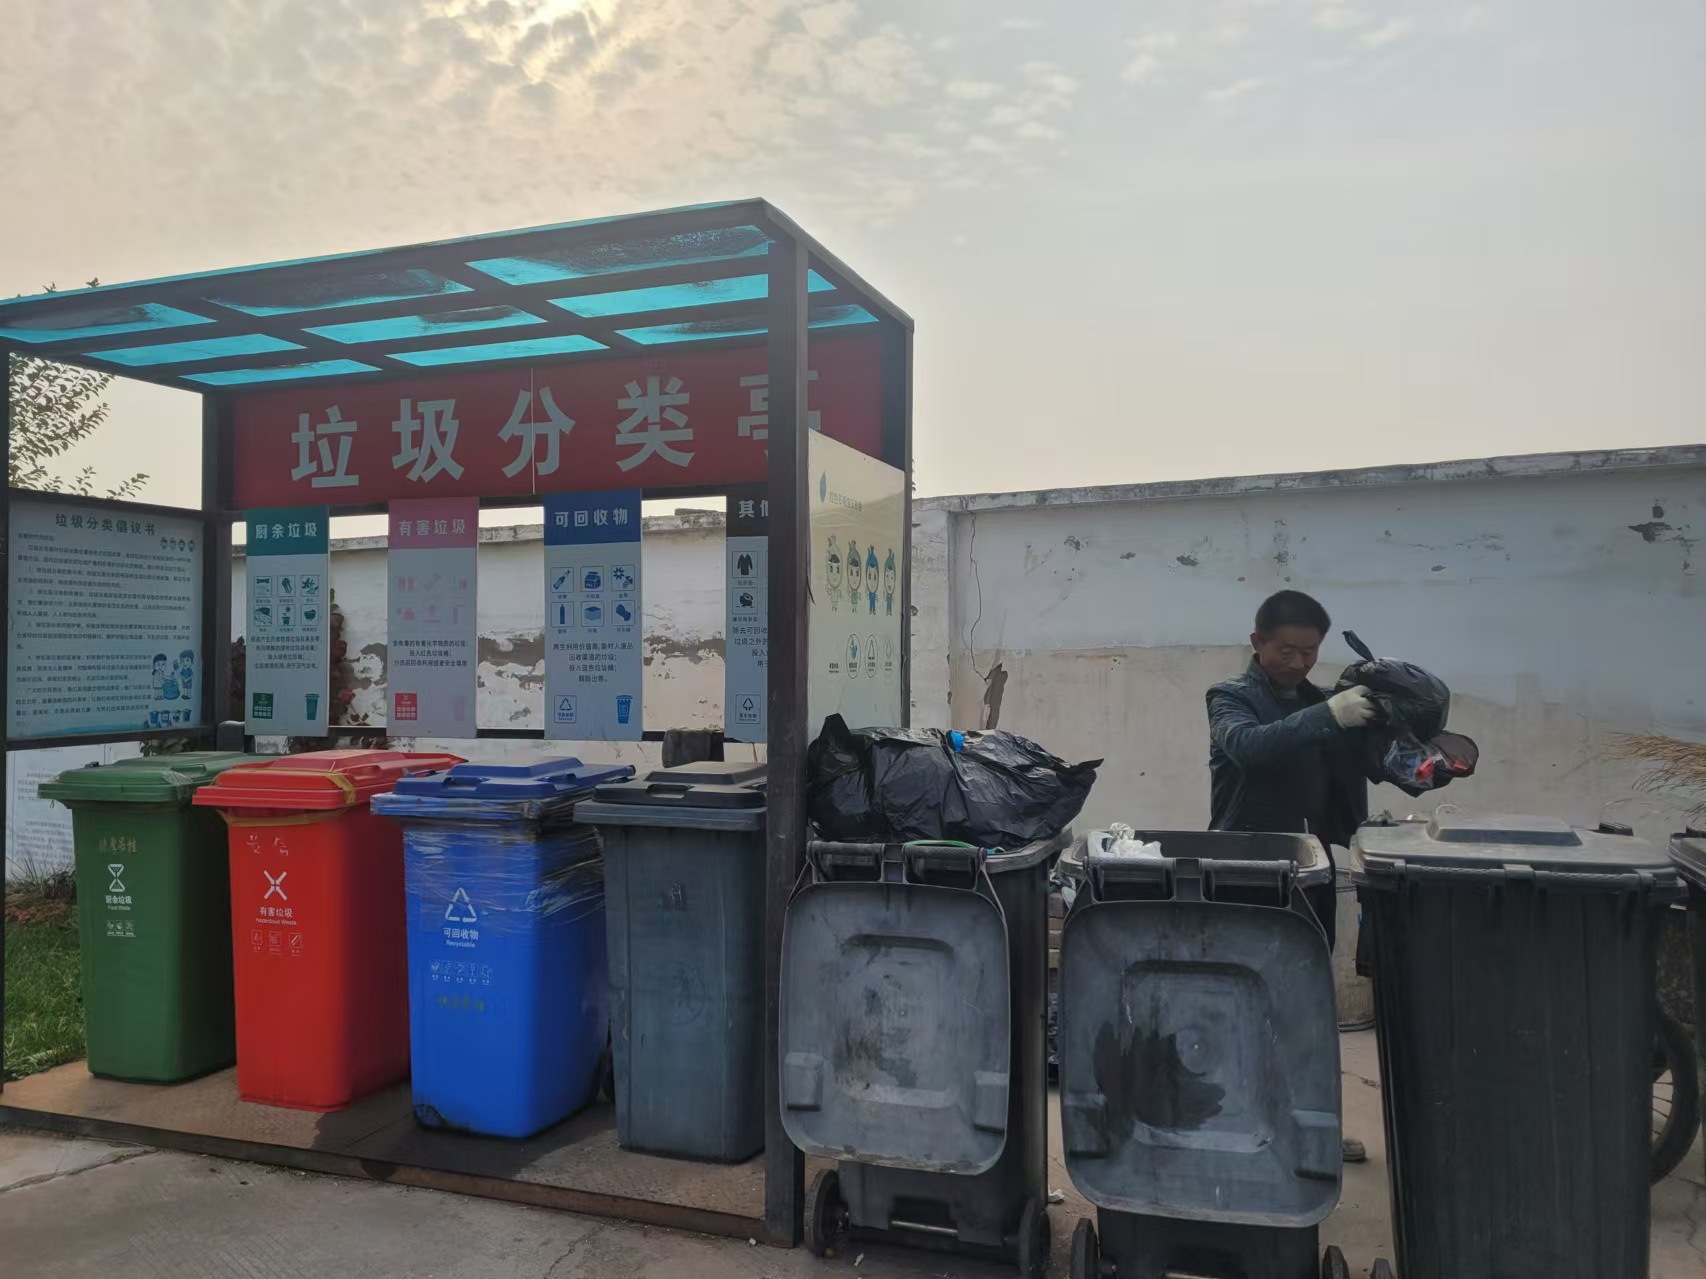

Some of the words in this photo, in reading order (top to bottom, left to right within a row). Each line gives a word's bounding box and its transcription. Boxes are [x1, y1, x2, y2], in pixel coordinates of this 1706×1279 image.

[55, 513, 157, 536] 垃圾分类倡议书
[554, 508, 628, 528] 可回收物
[255, 521, 318, 539] 厨余垃圾
[398, 519, 465, 537] 有害垃圾
[259, 906, 293, 918] 有害垃圾
[443, 927, 479, 940] 可回收物
[446, 940, 476, 948] Recyclable
